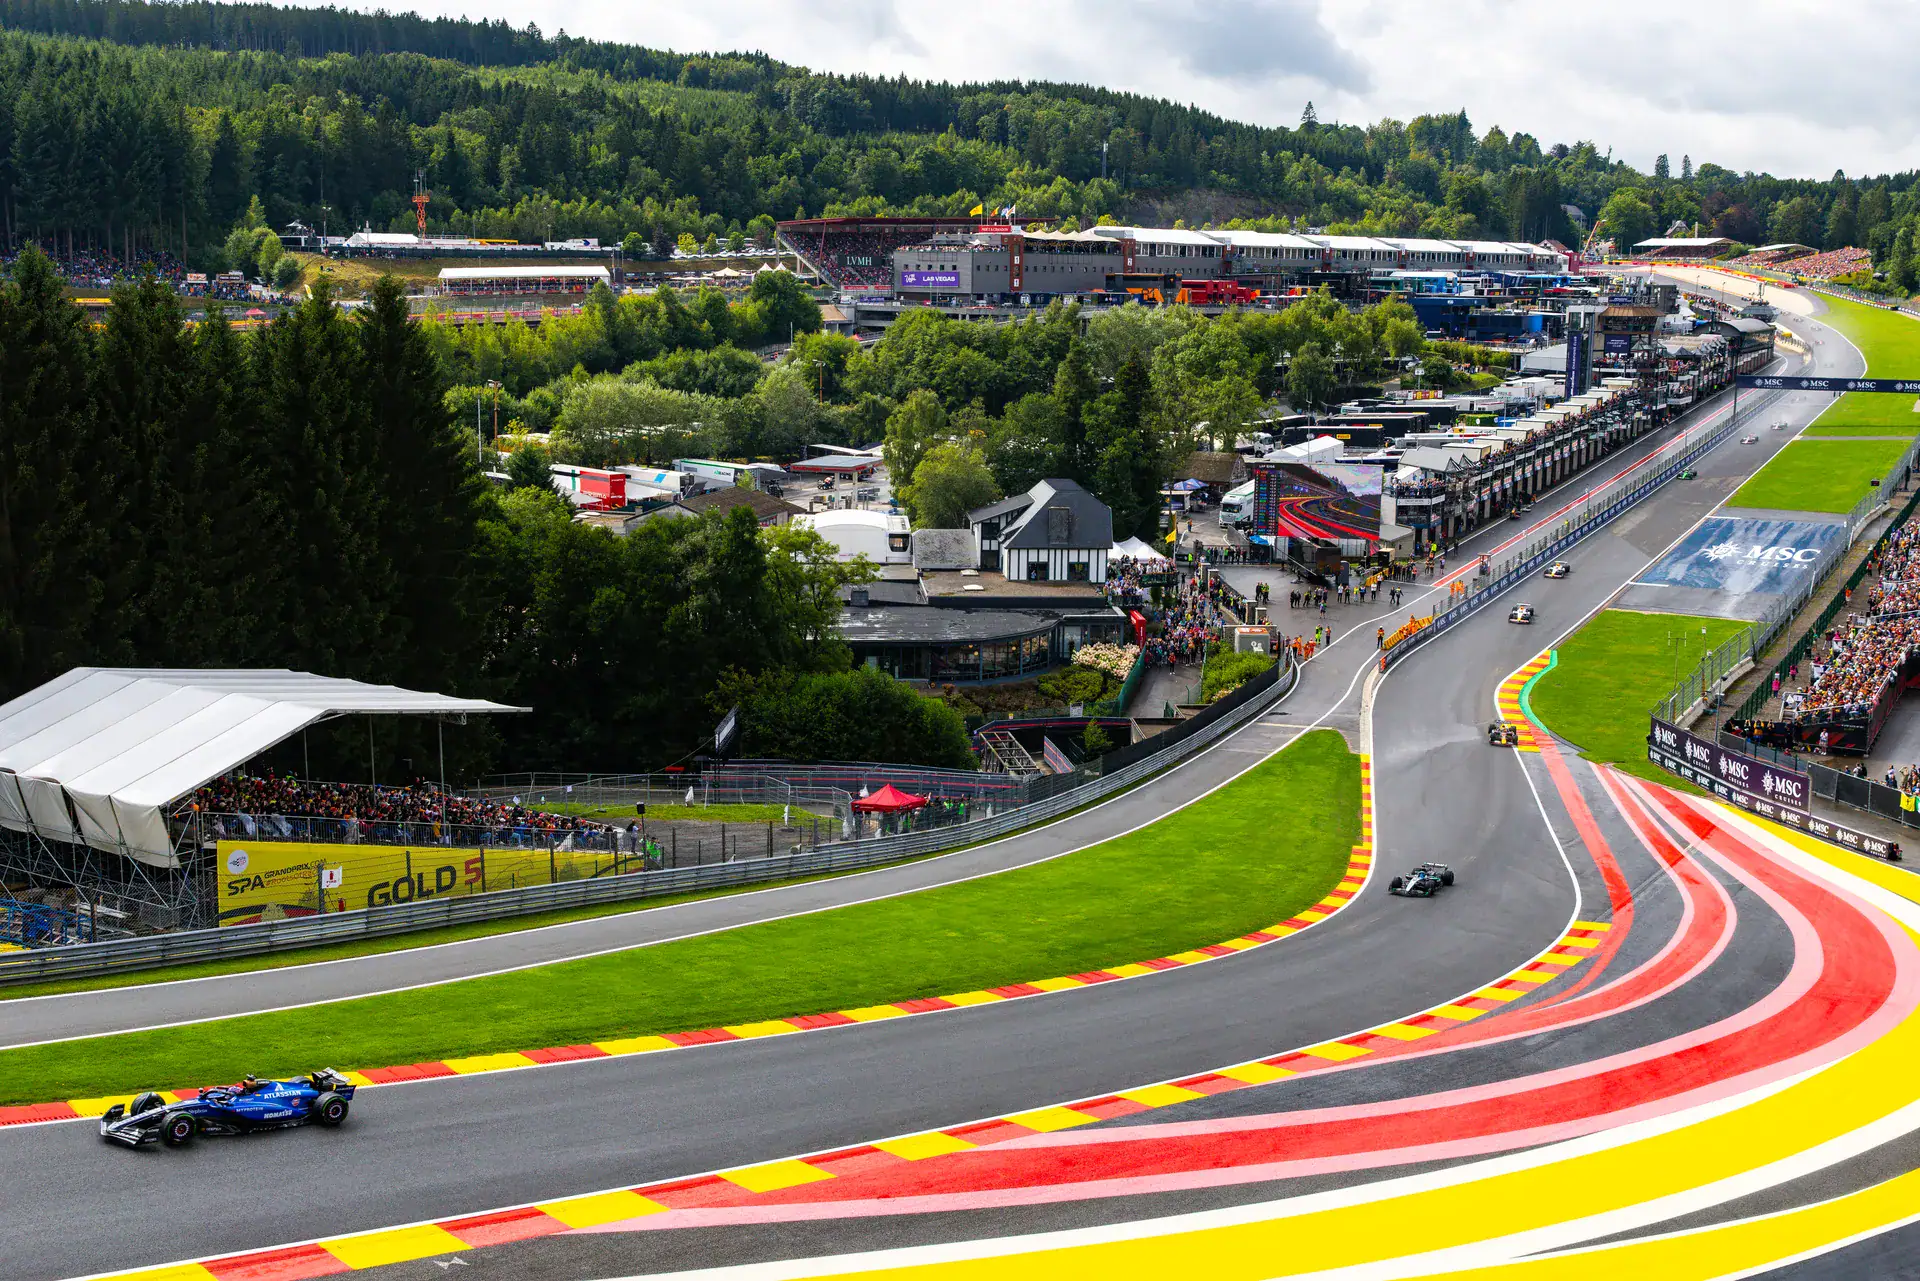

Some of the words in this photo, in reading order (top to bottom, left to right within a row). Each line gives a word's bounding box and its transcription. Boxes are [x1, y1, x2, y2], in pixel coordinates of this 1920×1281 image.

[846, 256, 872, 266] LVMH
[1764, 378, 1783, 386] MSC
[1856, 381, 1877, 389] MSC
[1742, 545, 1821, 562] MSC
[1736, 560, 1808, 569] CRUISES
[1661, 728, 1677, 747] MSC
[1692, 743, 1710, 763] MSC
[1727, 759, 1749, 780] MSC
[1728, 776, 1749, 788] CRUISES
[1775, 776, 1801, 798] MSC
[1718, 785, 1728, 795] MSC
[1736, 793, 1748, 805] MSC
[1774, 794, 1802, 807] CRUISES
[1761, 802, 1774, 814] MSC
[1787, 812, 1800, 823] MSC
[1815, 822, 1829, 834] MSC
[1842, 832, 1858, 844] MSC
[1870, 841, 1887, 853] MSC
[227, 875, 265, 896] SPA
[367, 865, 457, 908] GOLD
[464, 857, 482, 886] 5
[264, 1090, 302, 1100] ATLASSIAN
[263, 1109, 293, 1119] KOMATSU
